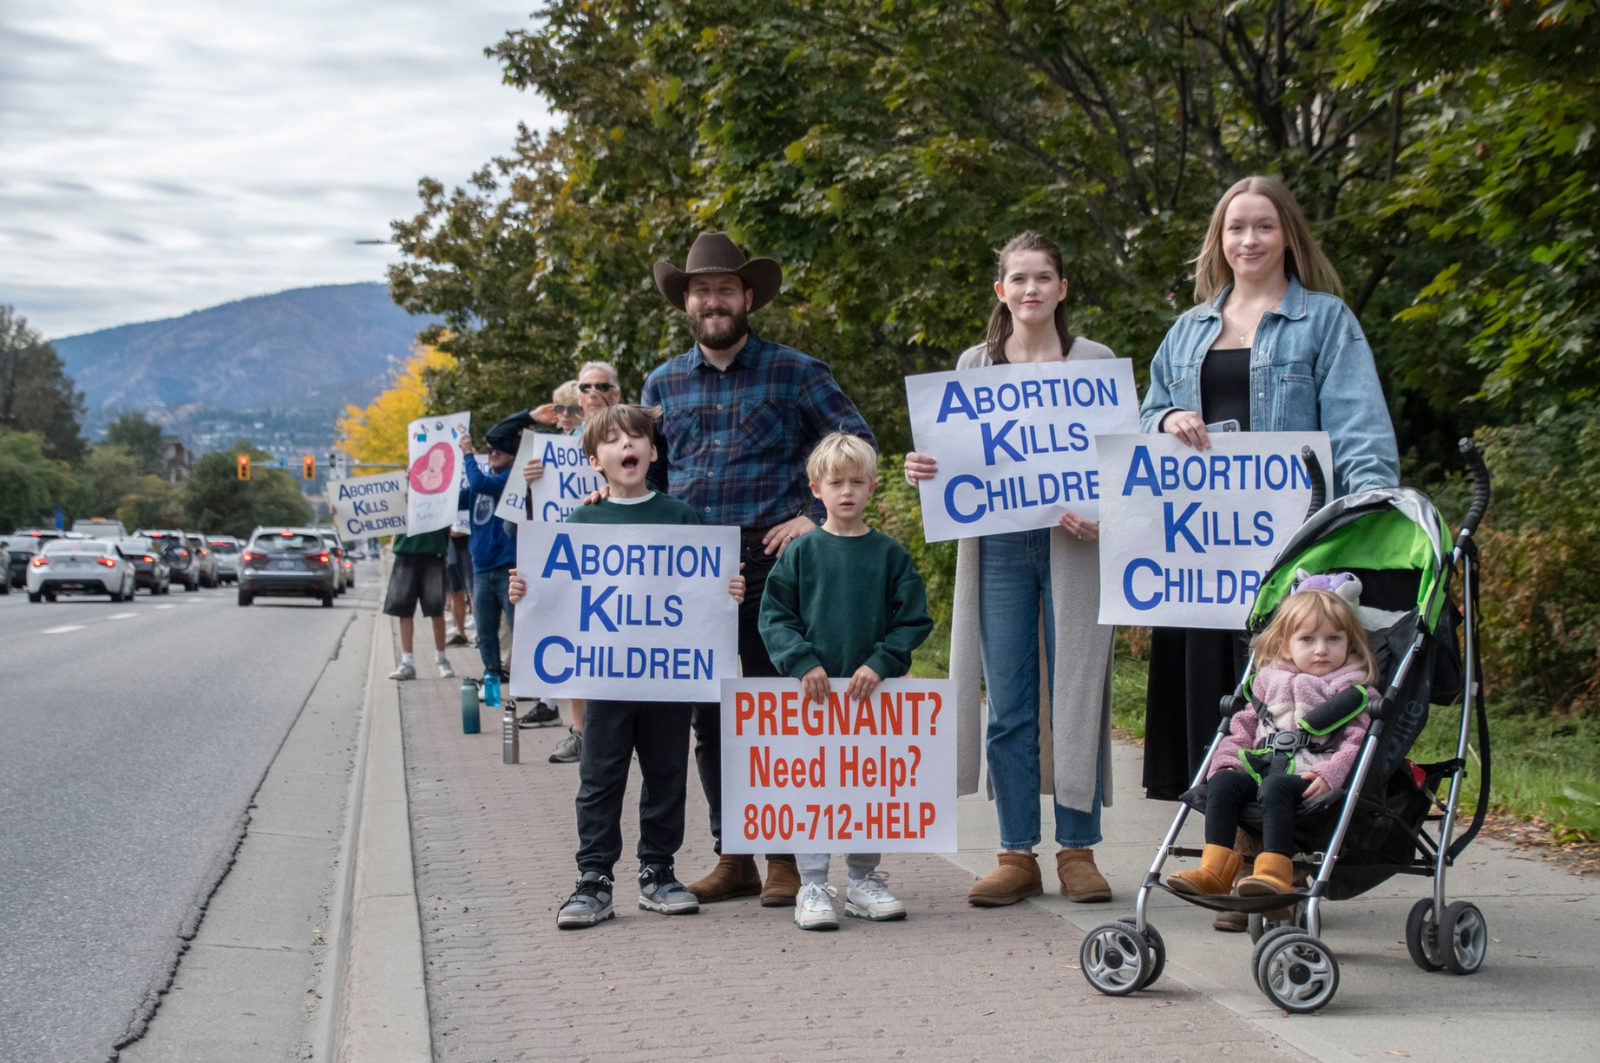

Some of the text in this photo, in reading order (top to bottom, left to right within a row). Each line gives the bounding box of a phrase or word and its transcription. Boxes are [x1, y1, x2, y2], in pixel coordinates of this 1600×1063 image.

[936, 377, 1119, 424] ABORTION
[542, 441, 590, 469] ABOR
[980, 418, 1090, 466] KILLS
[339, 479, 400, 501] ABORTION
[559, 472, 598, 500] KILL
[1122, 445, 1311, 497] ABORTION
[353, 500, 389, 517] KILLS
[944, 470, 1099, 524] CHILDRE
[347, 516, 406, 535] CHILDREN
[1163, 501, 1274, 554] KILLS
[541, 533, 722, 581] ABORTION
[1123, 557, 1261, 611] CHILDR
[579, 585, 683, 633] KILLS
[533, 635, 714, 685] CHILDREN
[736, 692, 942, 736] PREGNANT?
[750, 745, 921, 797] Need Help?
[744, 803, 936, 840] 800-712-HELP
